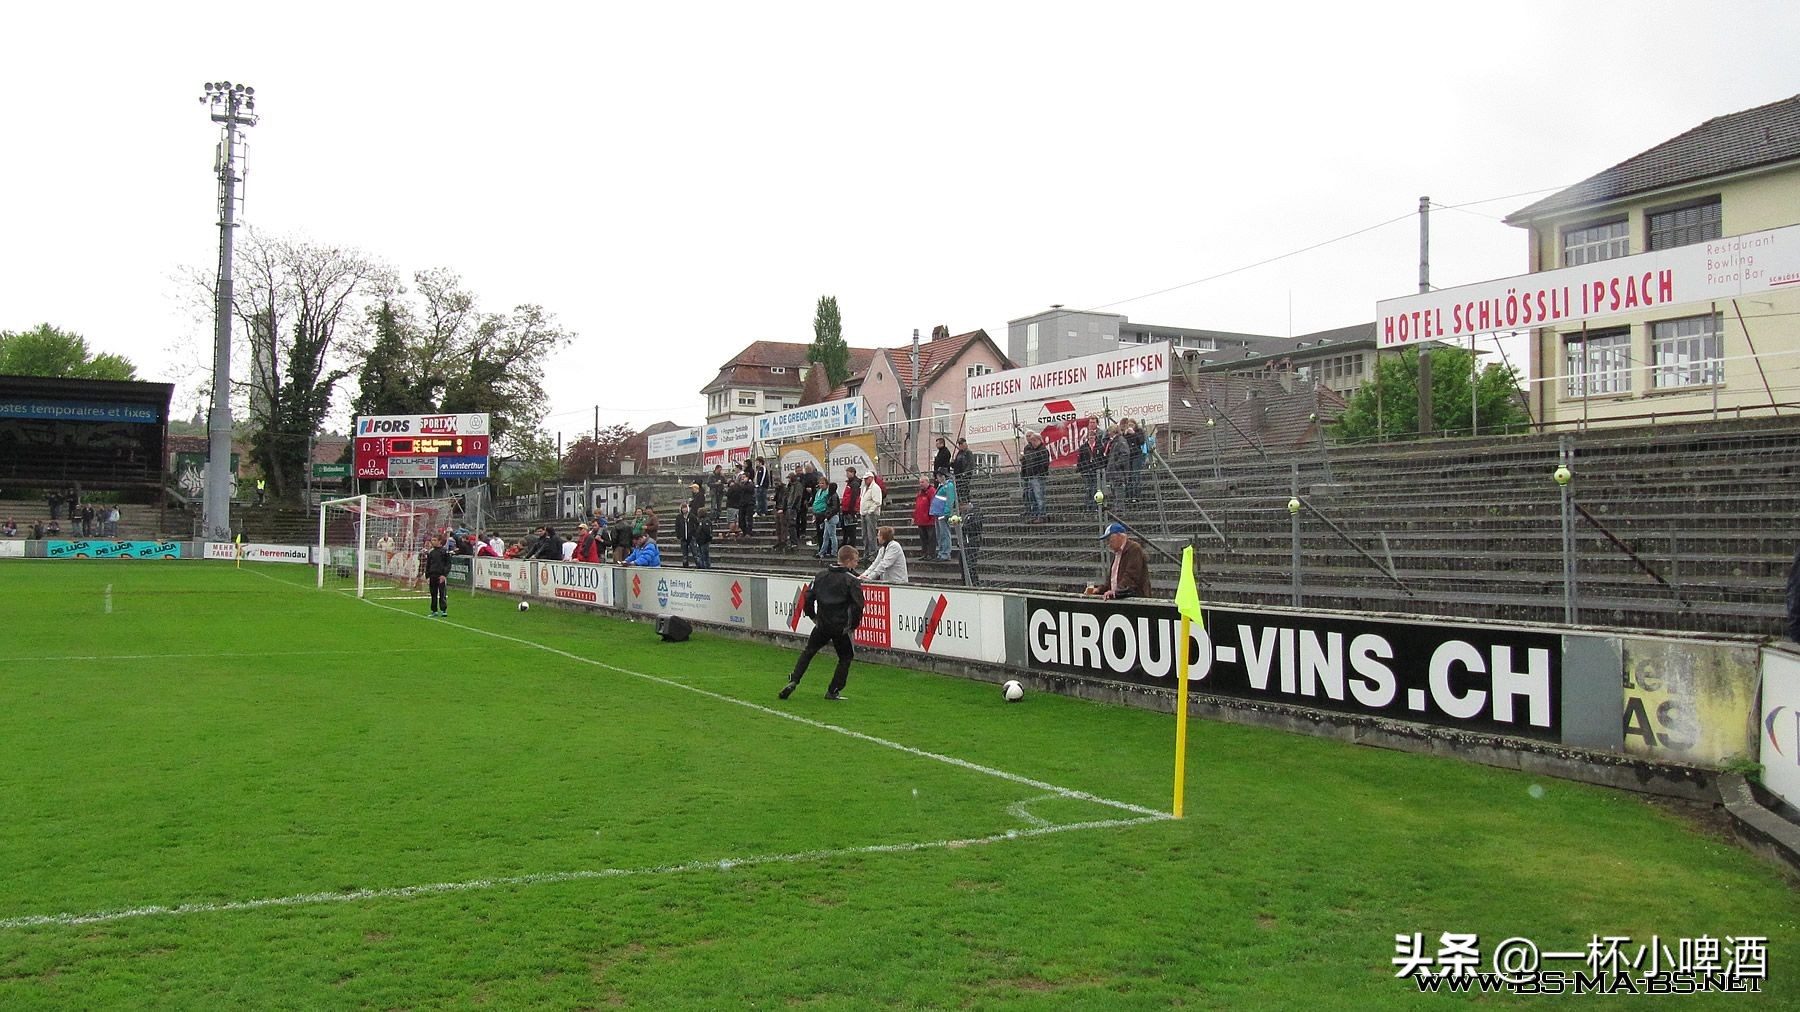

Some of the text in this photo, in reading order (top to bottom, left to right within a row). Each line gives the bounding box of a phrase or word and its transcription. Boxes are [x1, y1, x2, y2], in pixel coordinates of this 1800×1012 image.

[1707, 234, 1774, 256] Restaurant
[1707, 254, 1754, 271] Bowling
[1707, 268, 1764, 285] Piano Bar
[1384, 268, 1673, 345] HOTEL SCHLÖSSLI IPSACH
[970, 353, 1163, 400] RAIFFEISEN RAIFFEISEN RAIFFEISEN
[31, 403, 105, 417] temporaires
[107, 407, 121, 417] et
[124, 406, 151, 418] fixes
[788, 409, 818, 423] GREGORIO
[831, 405, 840, 416] SA
[374, 419, 410, 433] FORS
[1045, 421, 1089, 462] ivella
[358, 467, 385, 476] OMEGA
[449, 462, 485, 470] winterthur
[259, 548, 307, 559] herrennidau
[551, 565, 559, 585] V.
[898, 614, 969, 640] BAUGEO BIEL
[1028, 607, 1550, 728] GIROUD-VINS.CH
